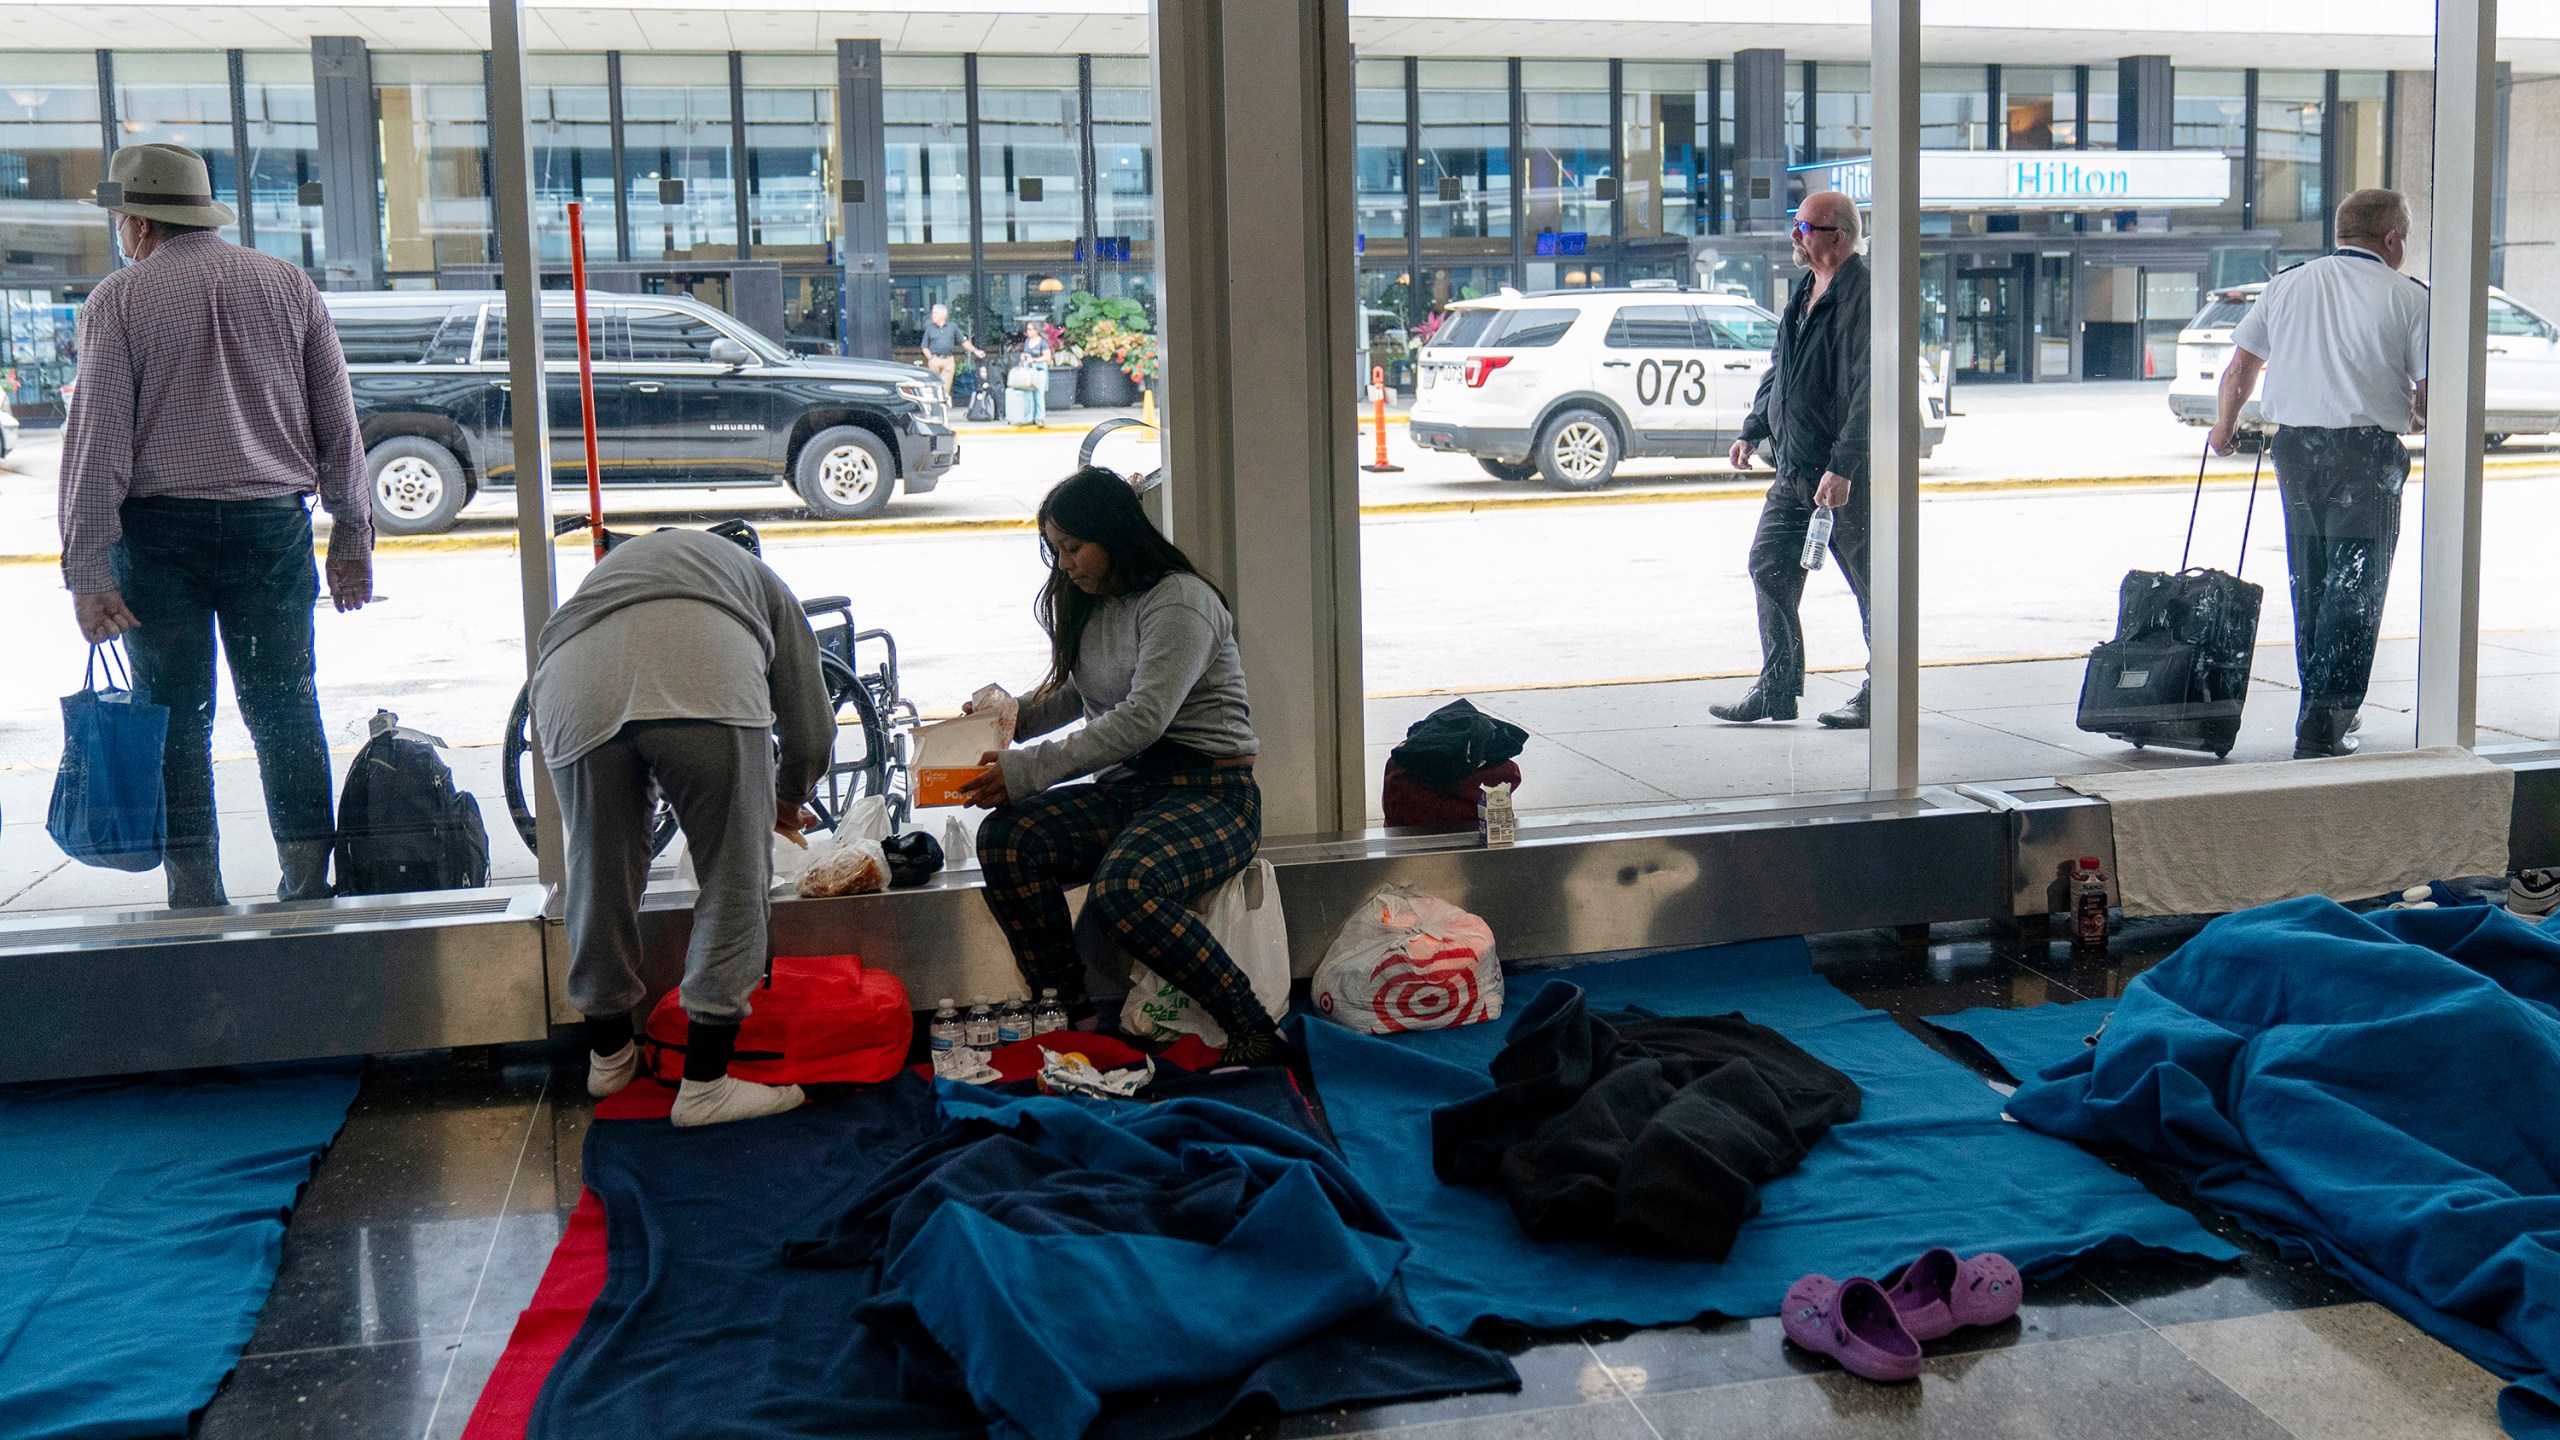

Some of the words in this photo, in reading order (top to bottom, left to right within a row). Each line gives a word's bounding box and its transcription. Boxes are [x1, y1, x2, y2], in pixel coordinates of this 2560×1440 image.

[1829, 163, 1872, 198] Hilto
[2017, 163, 2127, 194] Hilton
[1636, 359, 1705, 405] 073
